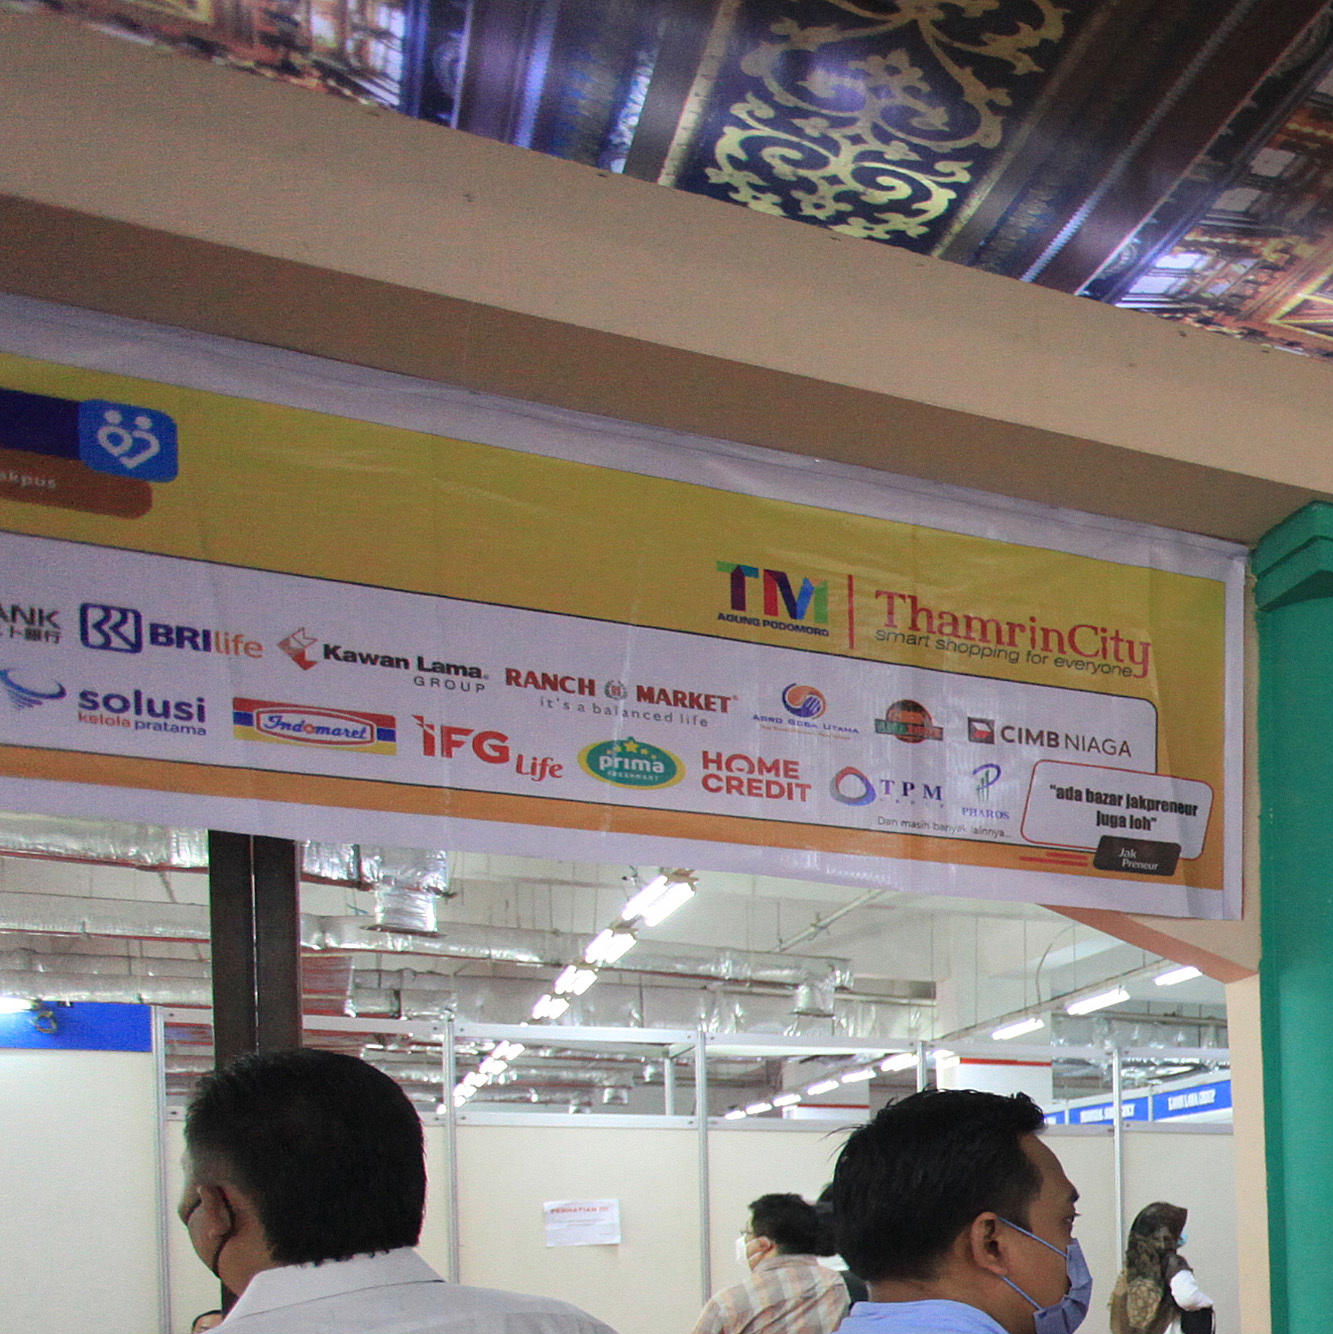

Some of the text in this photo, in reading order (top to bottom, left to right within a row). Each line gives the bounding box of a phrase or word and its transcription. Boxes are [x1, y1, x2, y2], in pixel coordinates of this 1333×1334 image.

[716, 560, 829, 624] TM
[875, 590, 1151, 679] ThamrinCity
[323, 643, 483, 680] Kawan Lama
[875, 629, 1133, 678] smart shopping for everyone
[413, 675, 486, 694] GROUP
[505, 668, 597, 697] RANCH
[636, 684, 732, 714] MARKET
[78, 689, 207, 724] solusi
[540, 696, 709, 728] it's a balanced life
[78, 711, 208, 737] kelola pratama
[1000, 725, 1132, 758] CIMB NIAGA
[515, 753, 564, 783] Life
[598, 755, 666, 774] prima
[702, 750, 801, 780] HOME
[701, 772, 812, 803] CREDIT
[1085, 787, 1124, 808] bazar
[877, 815, 899, 827] Dan
[900, 819, 930, 831] masih
[932, 821, 968, 835] banyak
[961, 806, 1010, 820] PHAROS
[1118, 847, 1138, 860] Jak
[1121, 858, 1160, 871] Preneur
